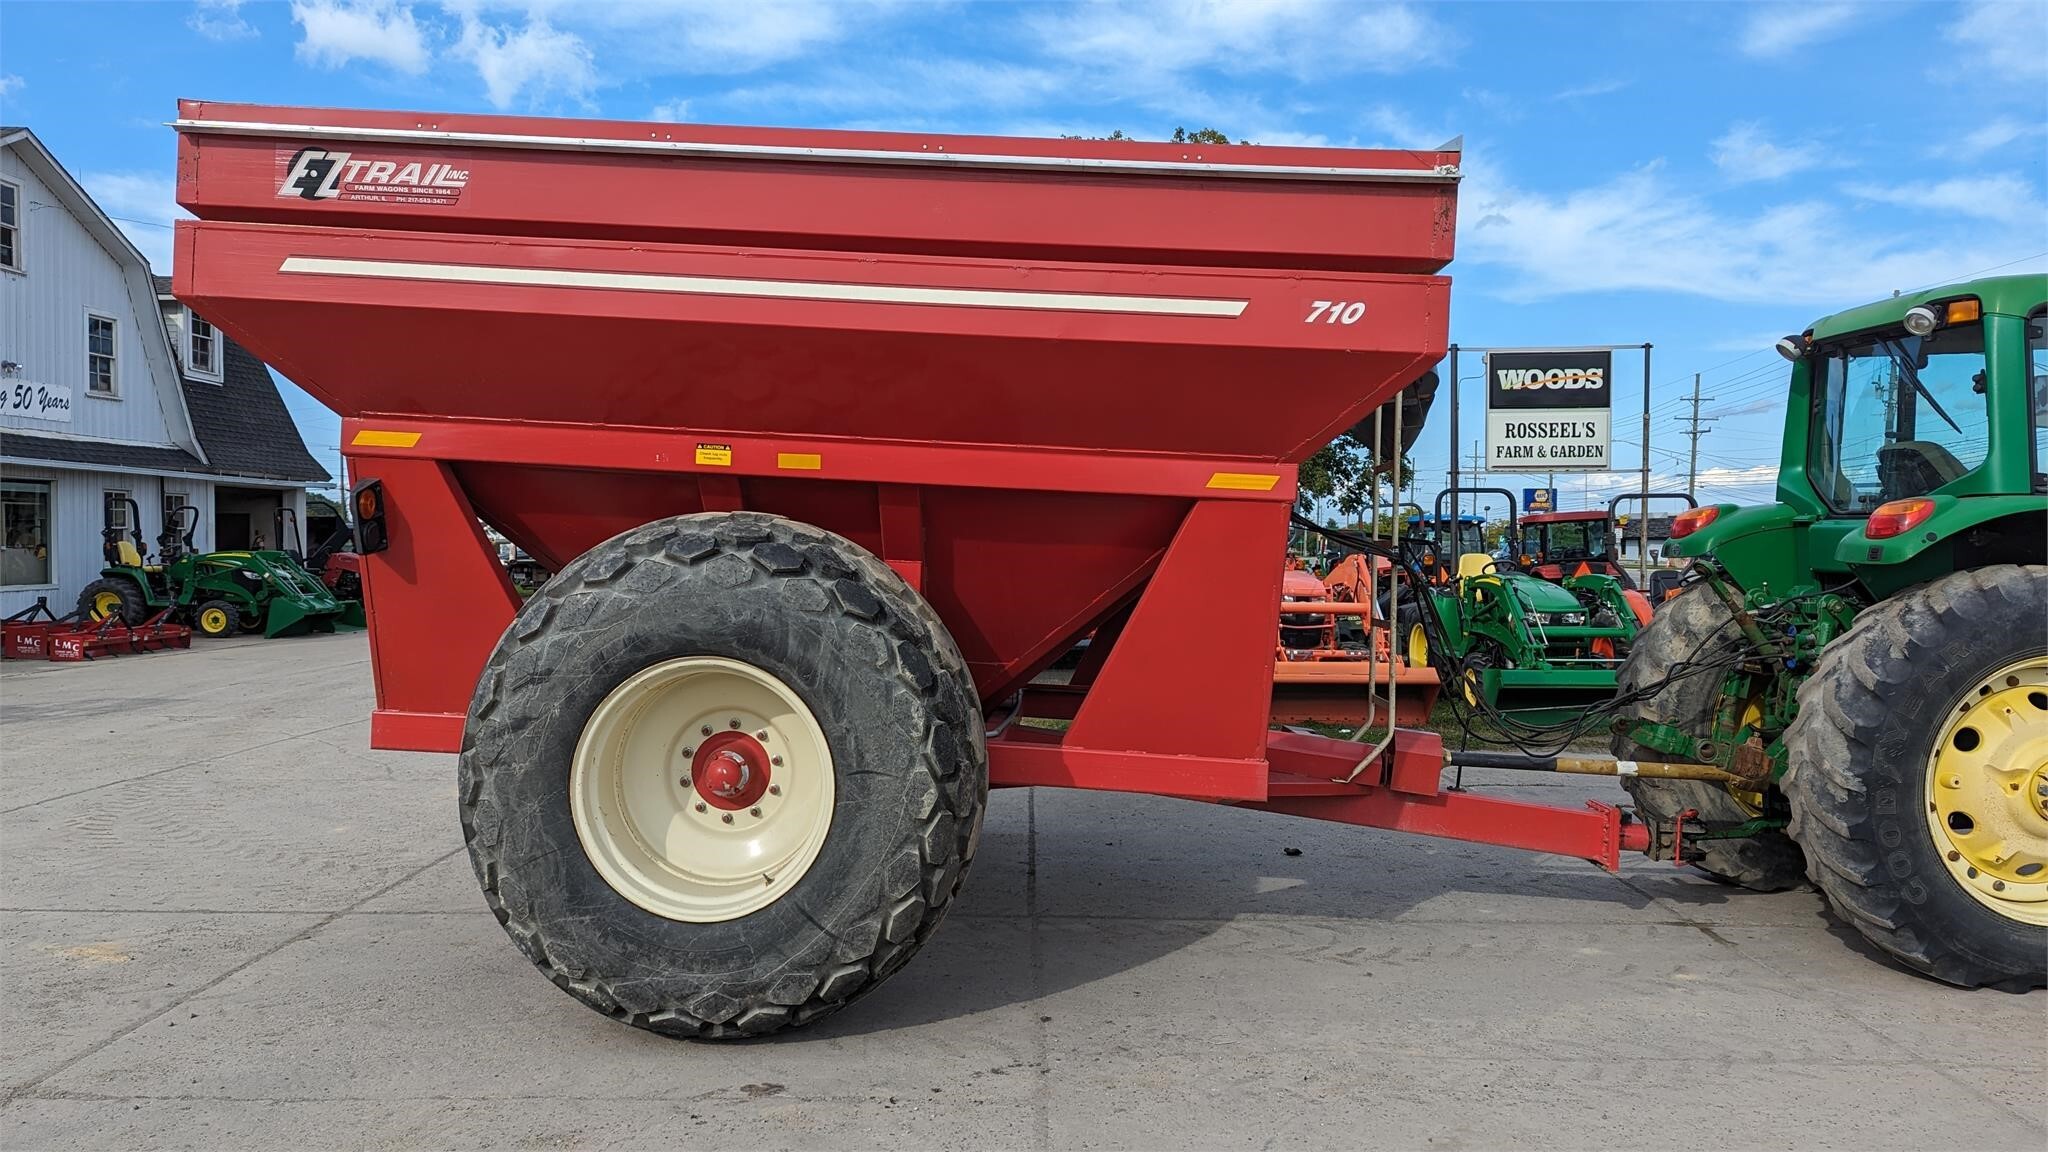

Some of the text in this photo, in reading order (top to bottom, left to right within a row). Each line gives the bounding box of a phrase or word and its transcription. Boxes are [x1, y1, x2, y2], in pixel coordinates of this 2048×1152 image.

[344, 159, 466, 188] TRAIL
[446, 169, 469, 180] INC.
[1304, 300, 1366, 325] 710
[1497, 368, 1604, 390] WOODS
[13, 384, 33, 410] 50
[38, 386, 70, 413] Years
[1505, 422, 1596, 439] ROSSEEL'S
[1496, 445, 1604, 458] FARM & GARDEN
[55, 639, 80, 651] LMC
